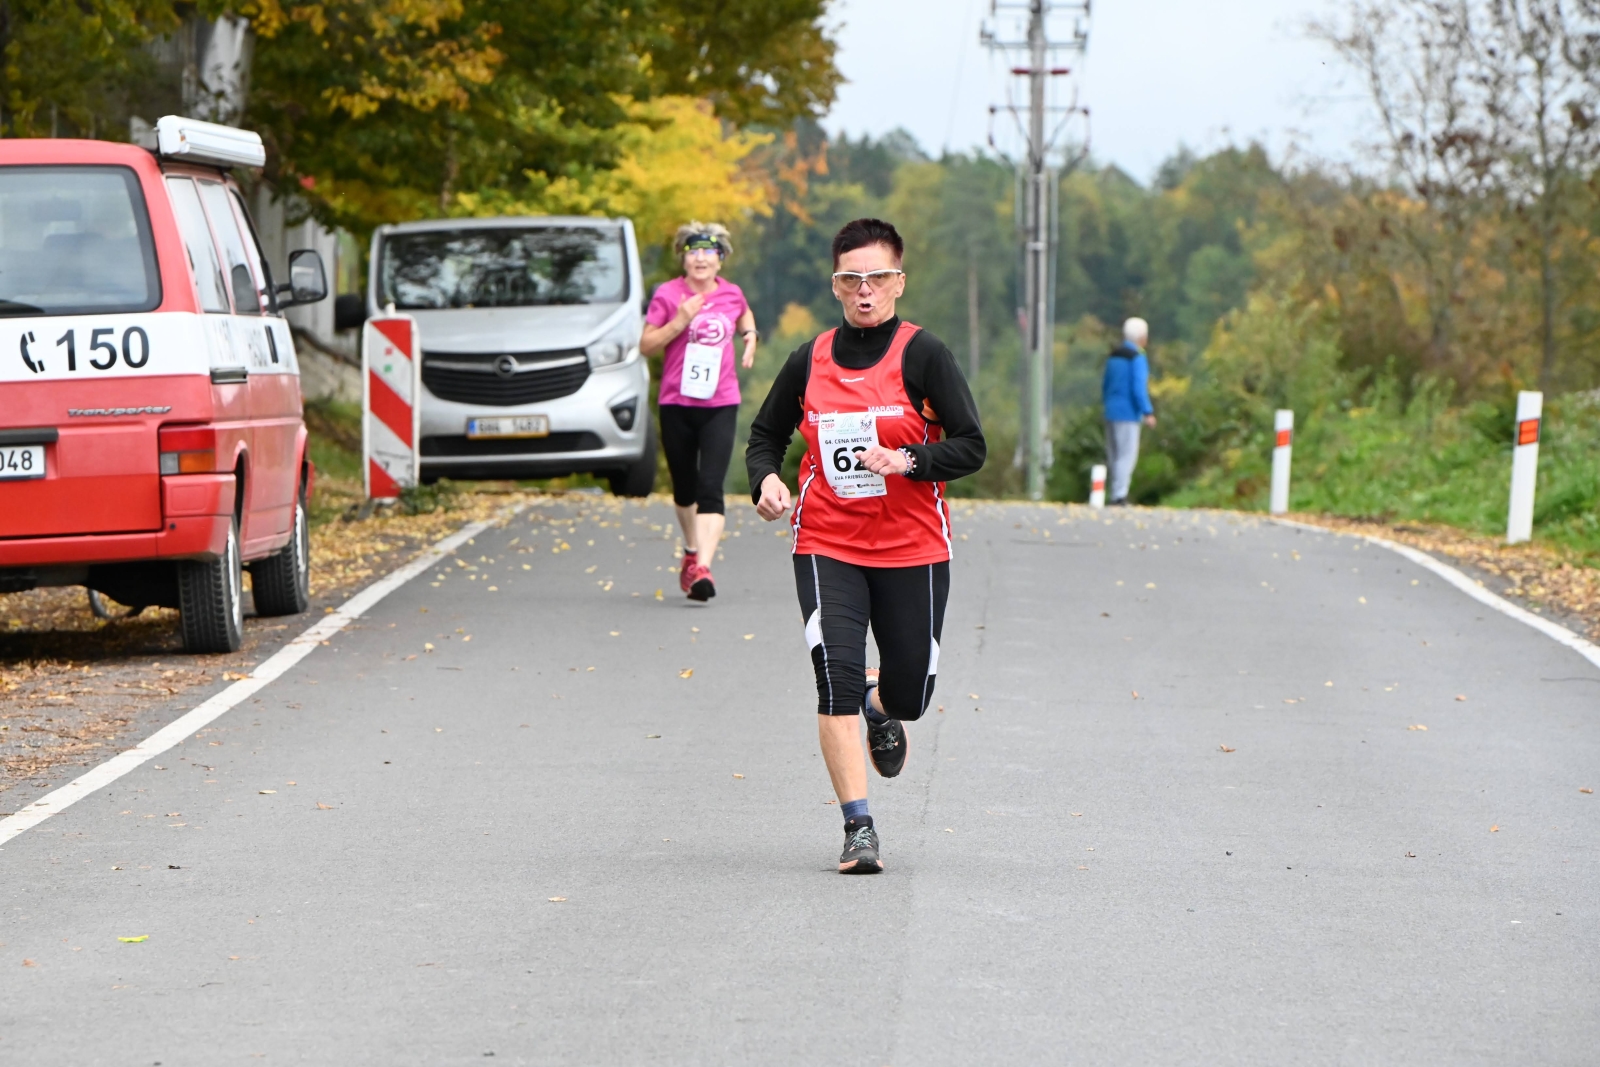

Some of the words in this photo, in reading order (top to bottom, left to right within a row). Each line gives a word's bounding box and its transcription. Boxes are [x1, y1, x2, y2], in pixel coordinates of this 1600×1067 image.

[56, 326, 150, 371] 150
[690, 365, 710, 382] 51
[68, 404, 172, 418] Transporter
[833, 445, 869, 473] 62
